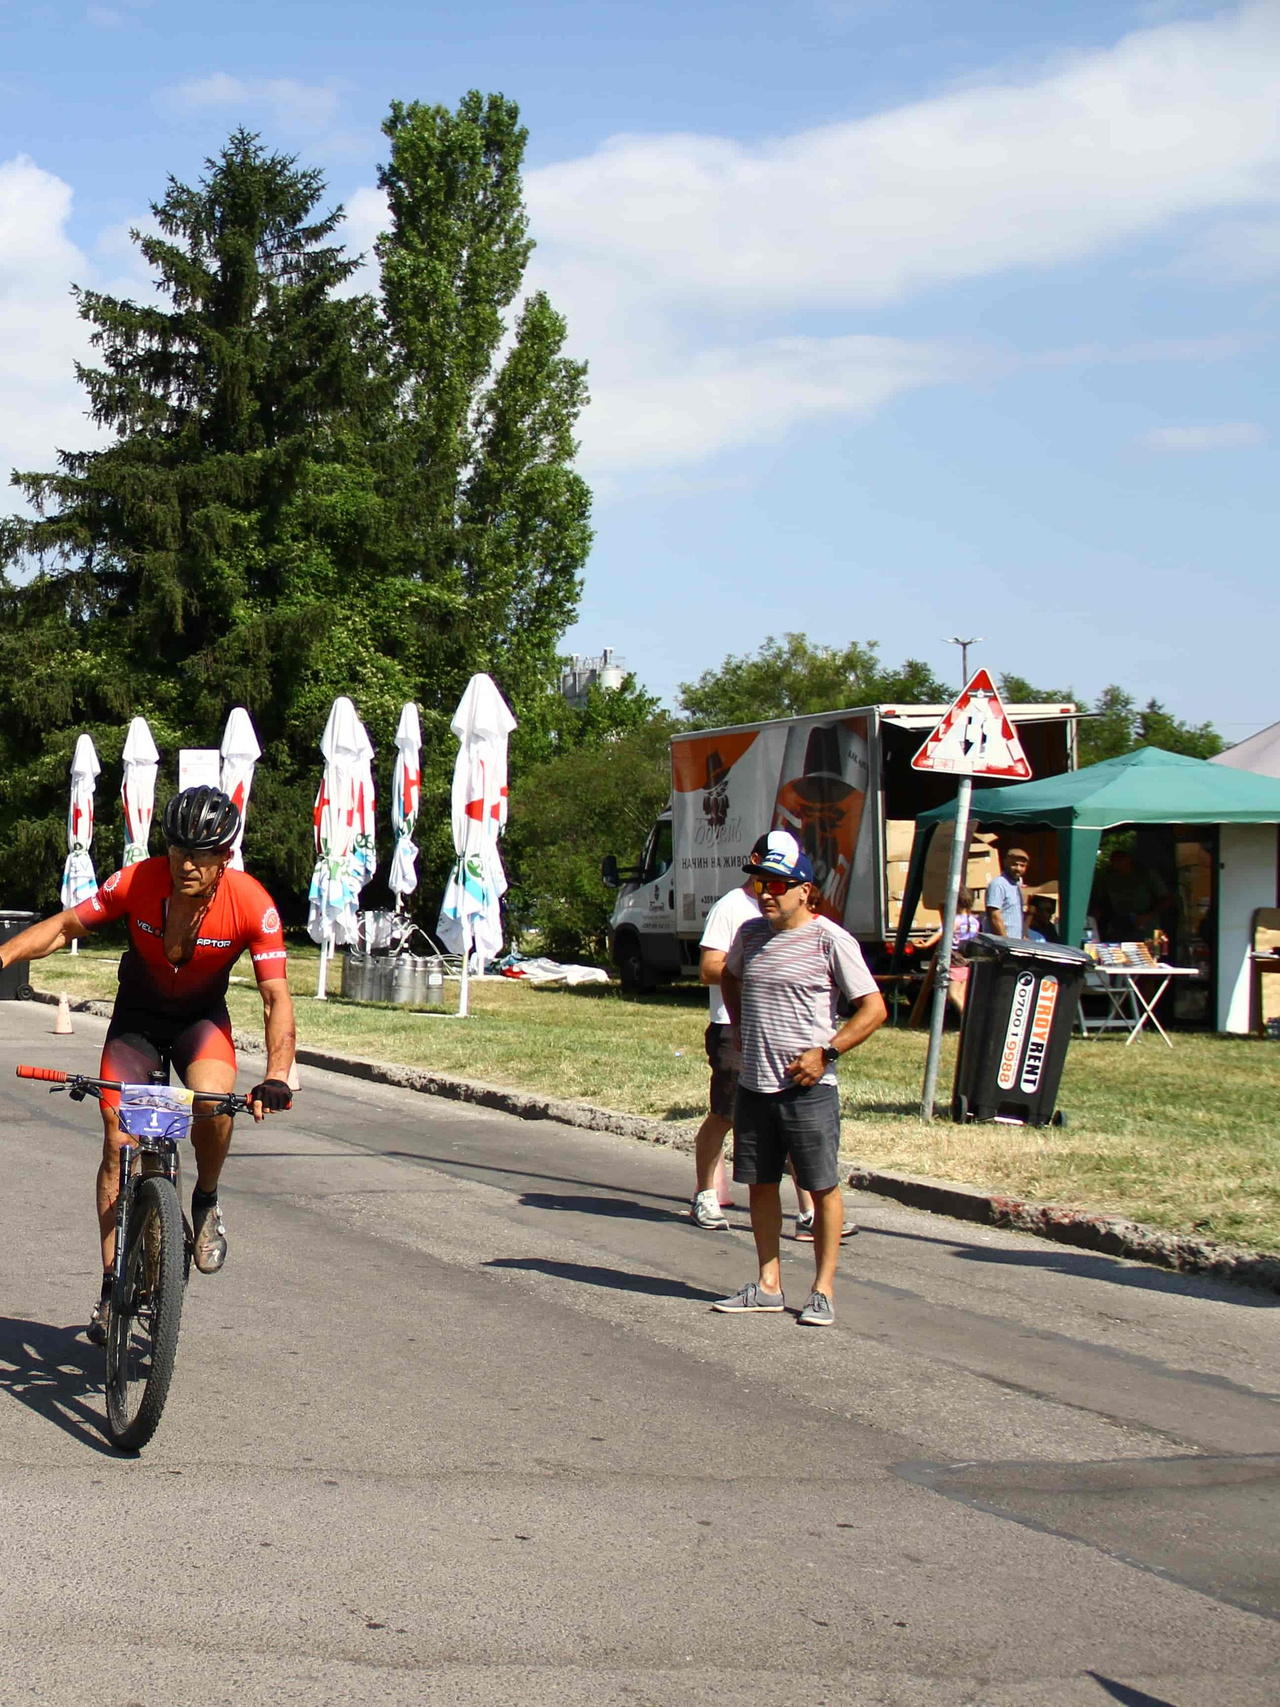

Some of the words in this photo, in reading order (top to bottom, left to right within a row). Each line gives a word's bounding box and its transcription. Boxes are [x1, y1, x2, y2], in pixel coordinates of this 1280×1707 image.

[681, 857, 709, 869] НАЧИН
[710, 857, 722, 869] НА
[999, 1041, 1017, 1083] 9988
[149, 1112, 159, 1127] 1
